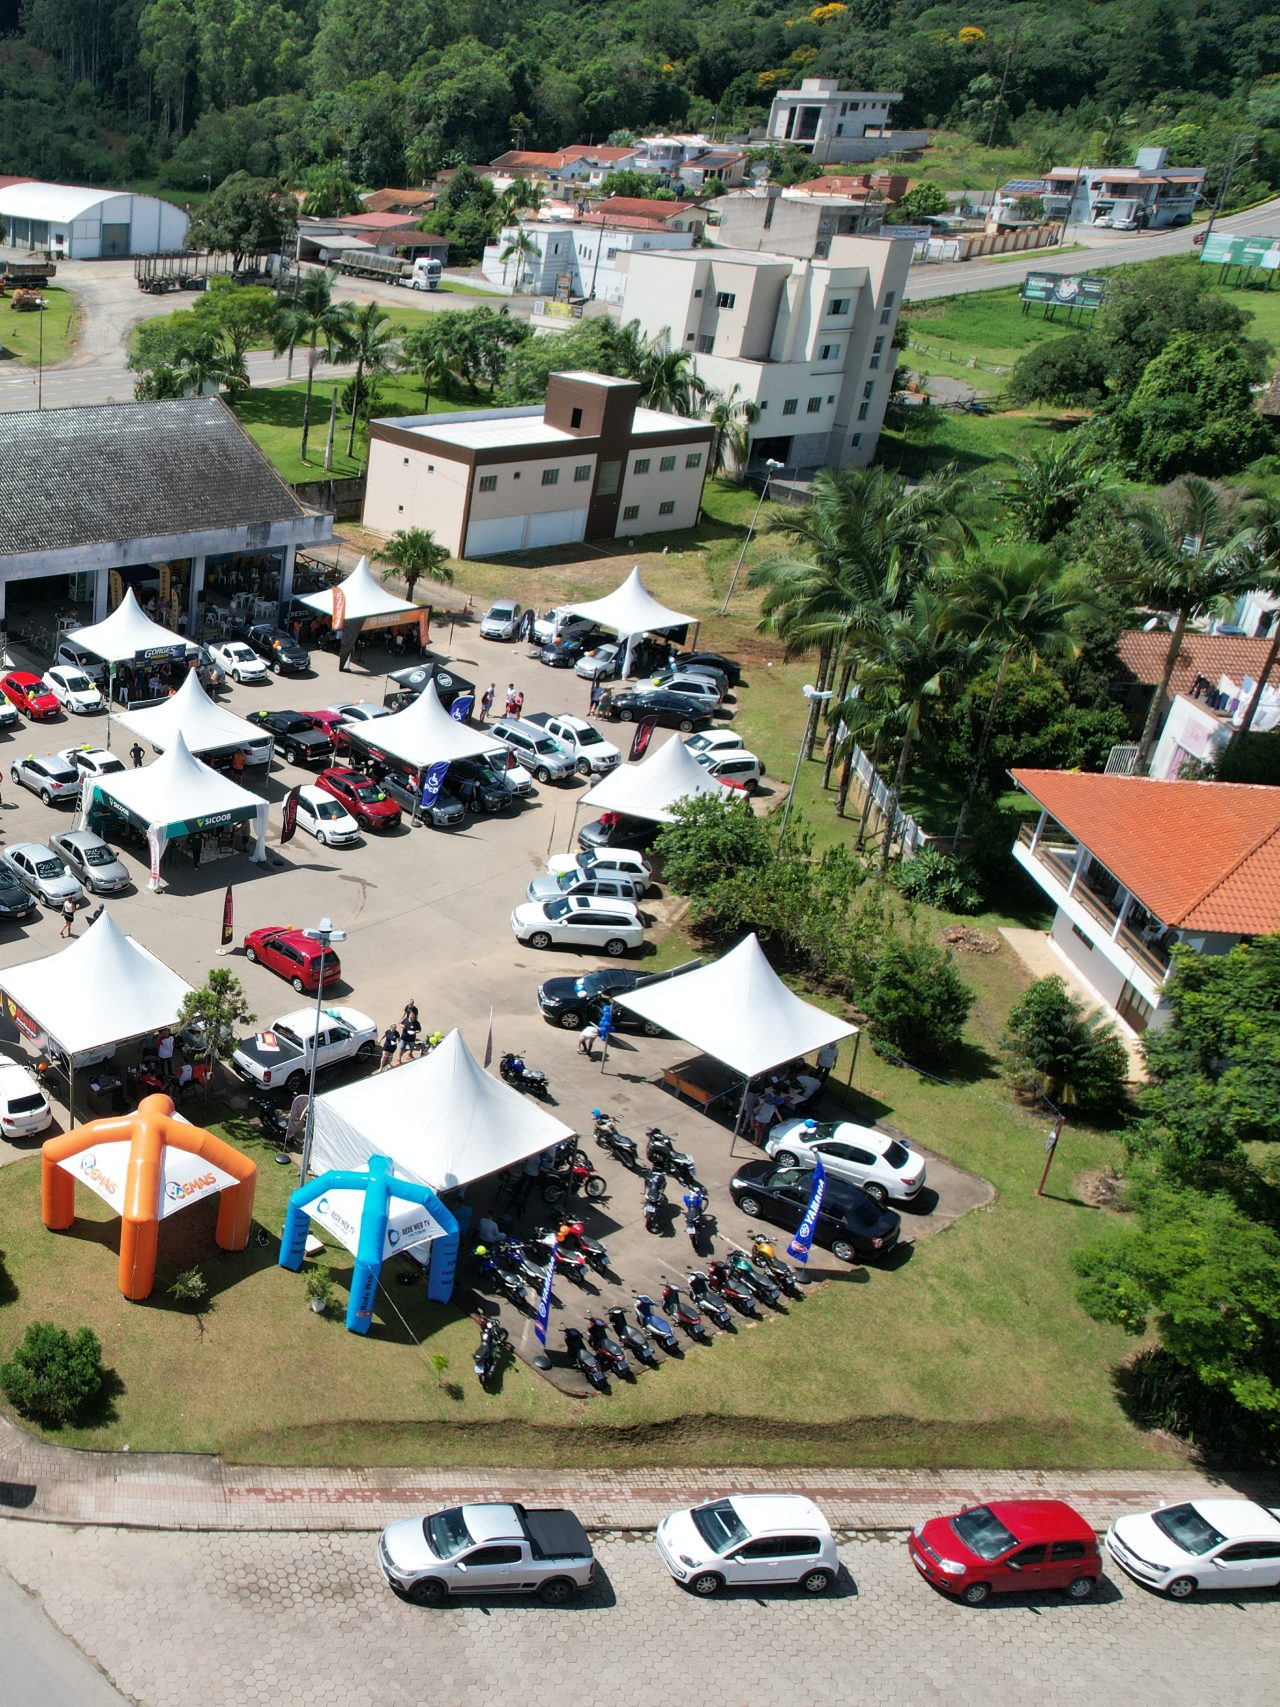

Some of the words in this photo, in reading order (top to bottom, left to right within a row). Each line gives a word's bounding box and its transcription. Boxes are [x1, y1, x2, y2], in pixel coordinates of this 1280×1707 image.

[378, 615, 401, 623] CRESOL
[144, 646, 177, 659] GORGES
[424, 783, 439, 795] PcD
[204, 813, 232, 826] SICOOB
[805, 1178, 825, 1225] YAMAHA
[331, 1209, 342, 1223] REDE
[341, 1218, 351, 1230] WEB
[402, 1224, 414, 1235] REDE
[413, 1221, 424, 1231] WEB
[424, 1219, 431, 1227] TV
[541, 1256, 555, 1304] YAMAHA
